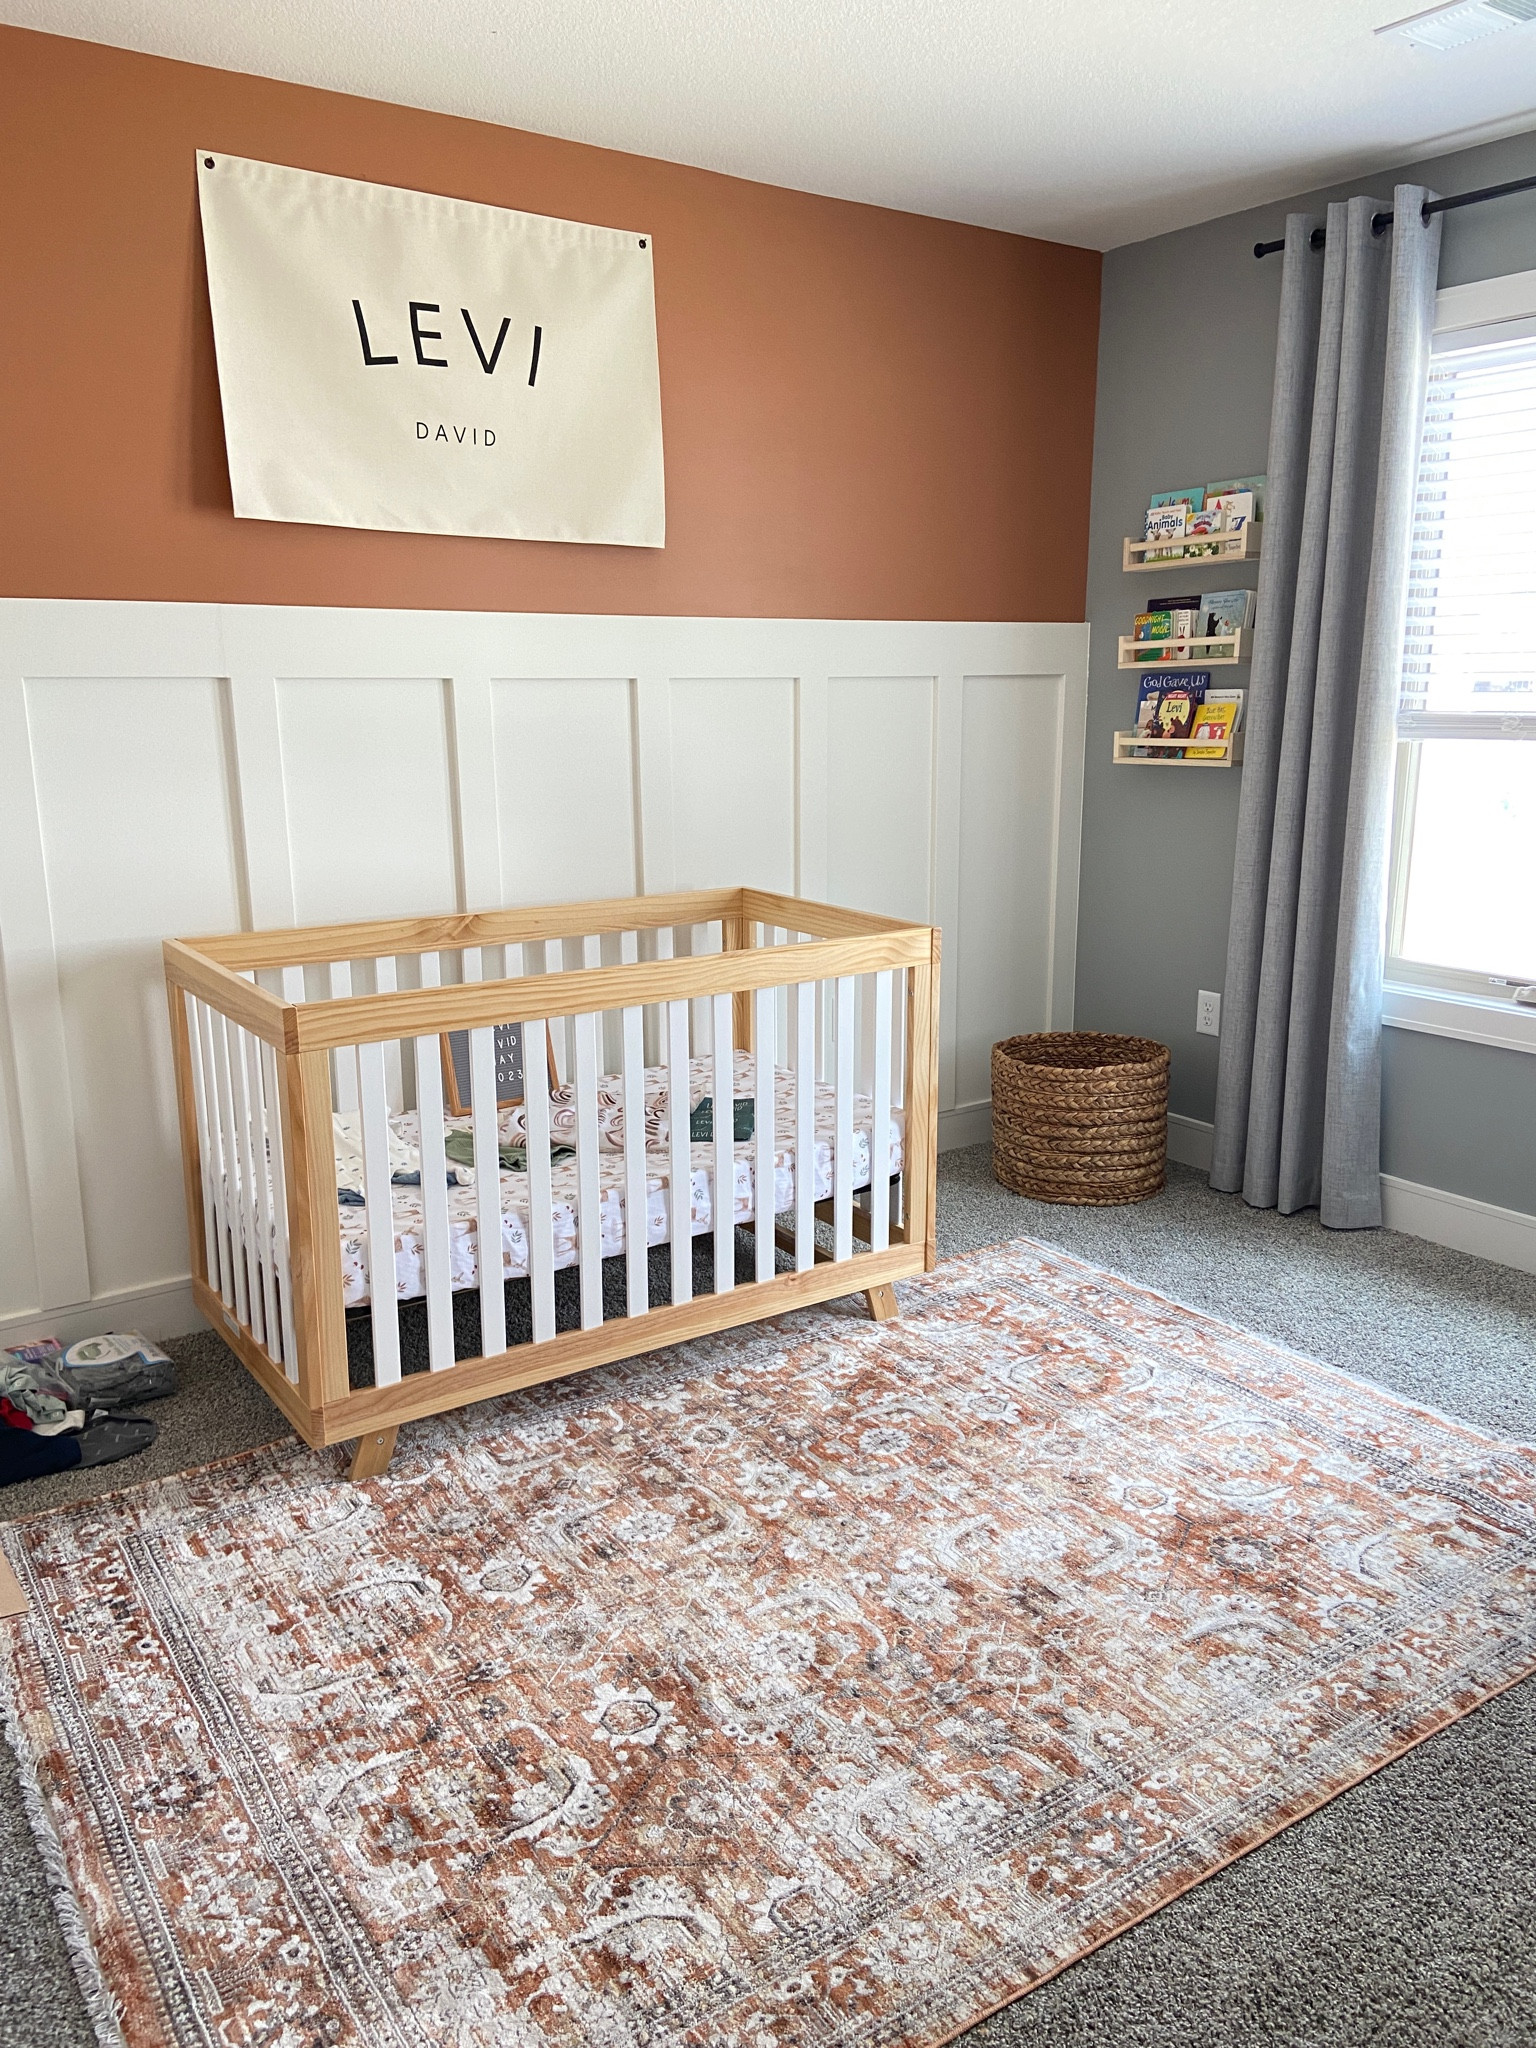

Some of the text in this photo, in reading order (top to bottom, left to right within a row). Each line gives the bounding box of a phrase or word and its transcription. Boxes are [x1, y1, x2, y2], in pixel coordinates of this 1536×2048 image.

[352, 299, 542, 387] LEVI
[416, 421, 496, 447] DAVID
[1148, 517, 1183, 530] Animals
[1143, 675, 1162, 688] God
[1163, 676, 1190, 690] Gave
[1166, 701, 1183, 713] Levi
[497, 1035, 517, 1049] VID
[500, 1053, 514, 1065] AY
[498, 1069, 524, 1082] 023
